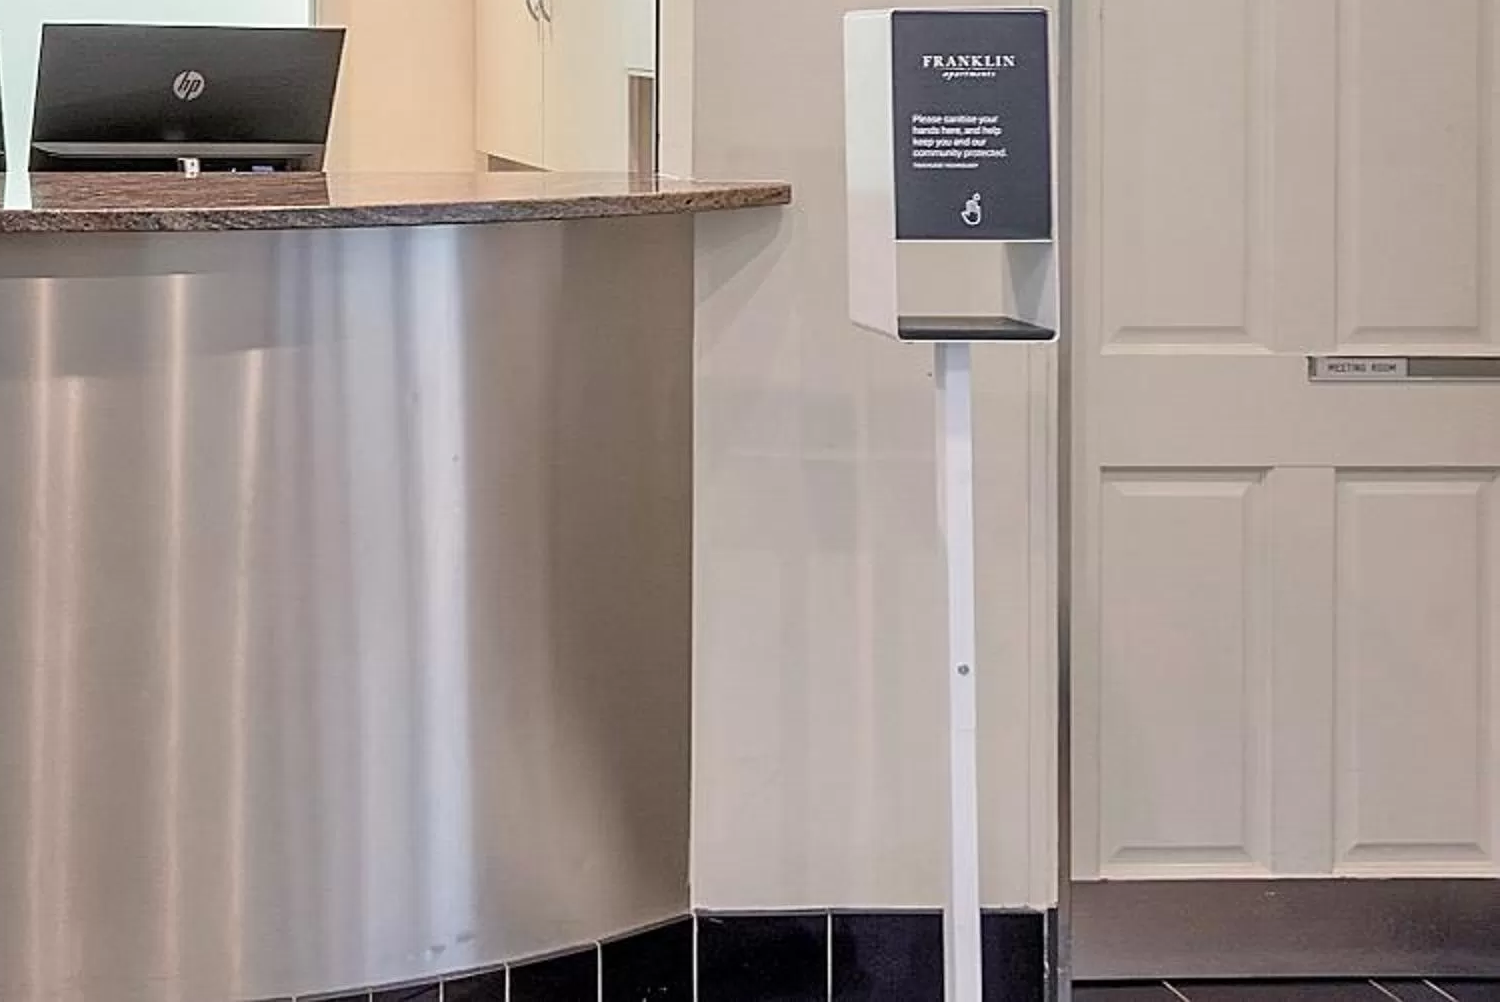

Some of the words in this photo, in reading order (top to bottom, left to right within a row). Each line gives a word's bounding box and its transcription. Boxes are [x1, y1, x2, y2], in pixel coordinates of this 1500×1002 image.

[923, 55, 1016, 67] FRANKLIN
[942, 71, 996, 80] apartments
[912, 115, 942, 124] Please
[978, 116, 999, 125] your
[912, 126, 940, 135] hands
[963, 126, 981, 135] and
[982, 126, 1002, 136] help
[912, 138, 934, 148] keep
[935, 139, 953, 148] you
[953, 138, 971, 147] and
[971, 139, 987, 147] our
[913, 149, 962, 158] community
